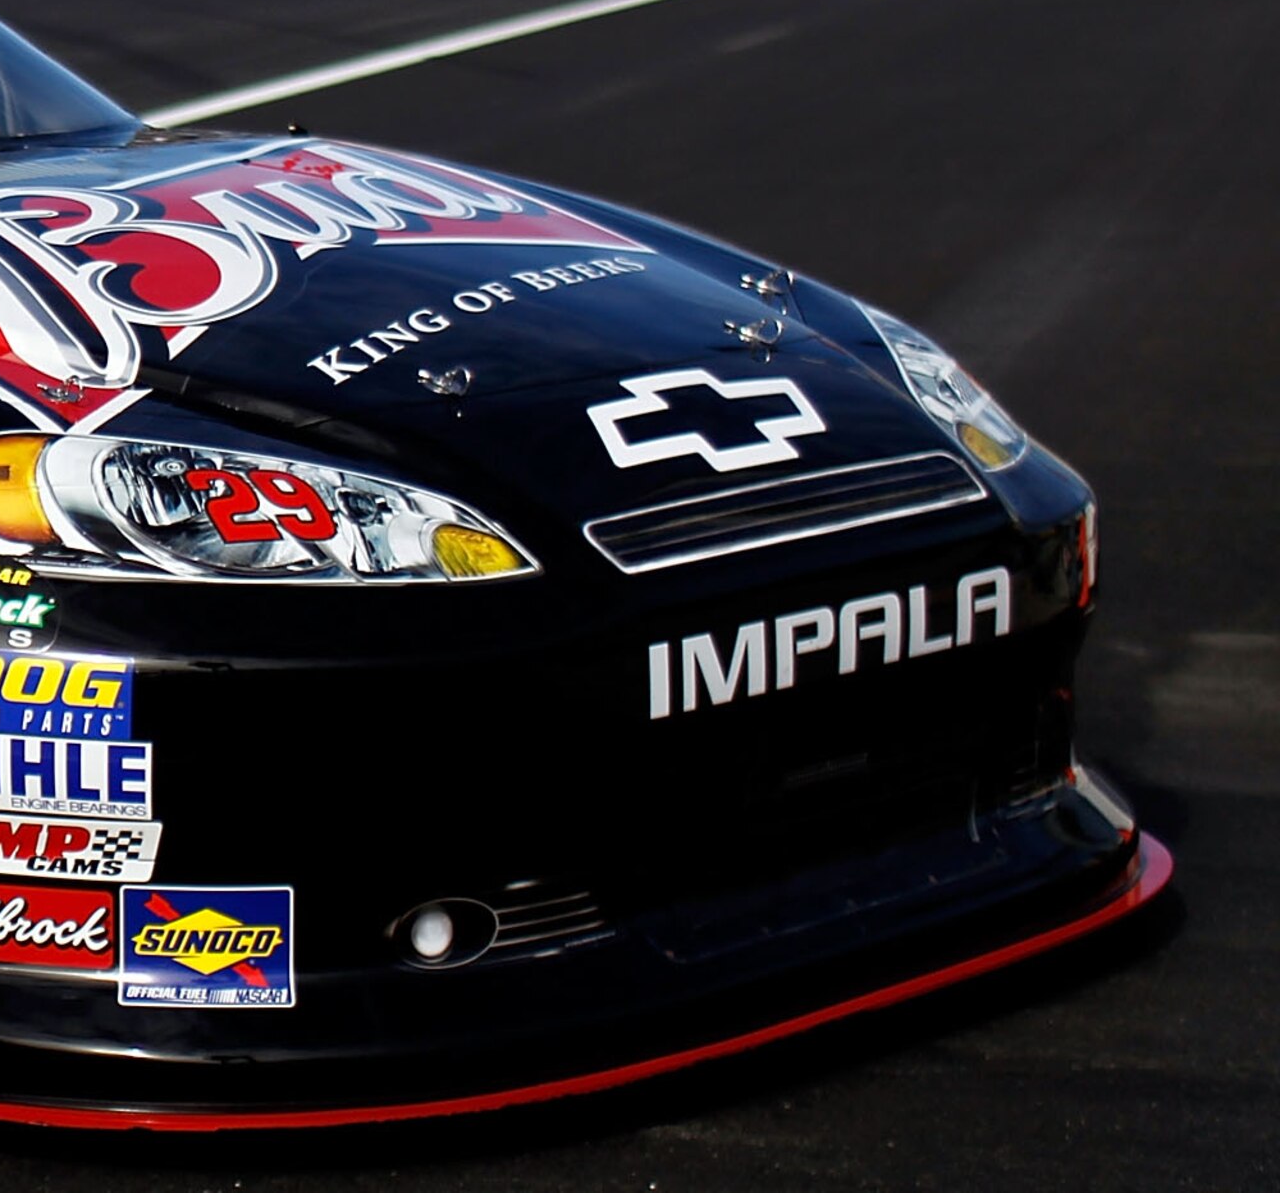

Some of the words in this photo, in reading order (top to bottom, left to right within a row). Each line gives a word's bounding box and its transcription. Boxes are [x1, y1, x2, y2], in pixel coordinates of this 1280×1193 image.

[306, 308, 451, 386] KING
[452, 281, 517, 314] OF
[512, 255, 646, 292] BEERS
[184, 469, 339, 544] 29
[648, 566, 1011, 720] IMPALA
[23, 708, 113, 737] PARTS
[10, 796, 67, 813] ENGINE
[68, 800, 147, 817] BEARINGS
[25, 854, 125, 877] CAMS
[139, 927, 279, 956] SUNOCO
[126, 985, 177, 1000] OFFICIAL
[178, 987, 208, 1001] FUEL
[234, 988, 288, 1004] NASCAR
